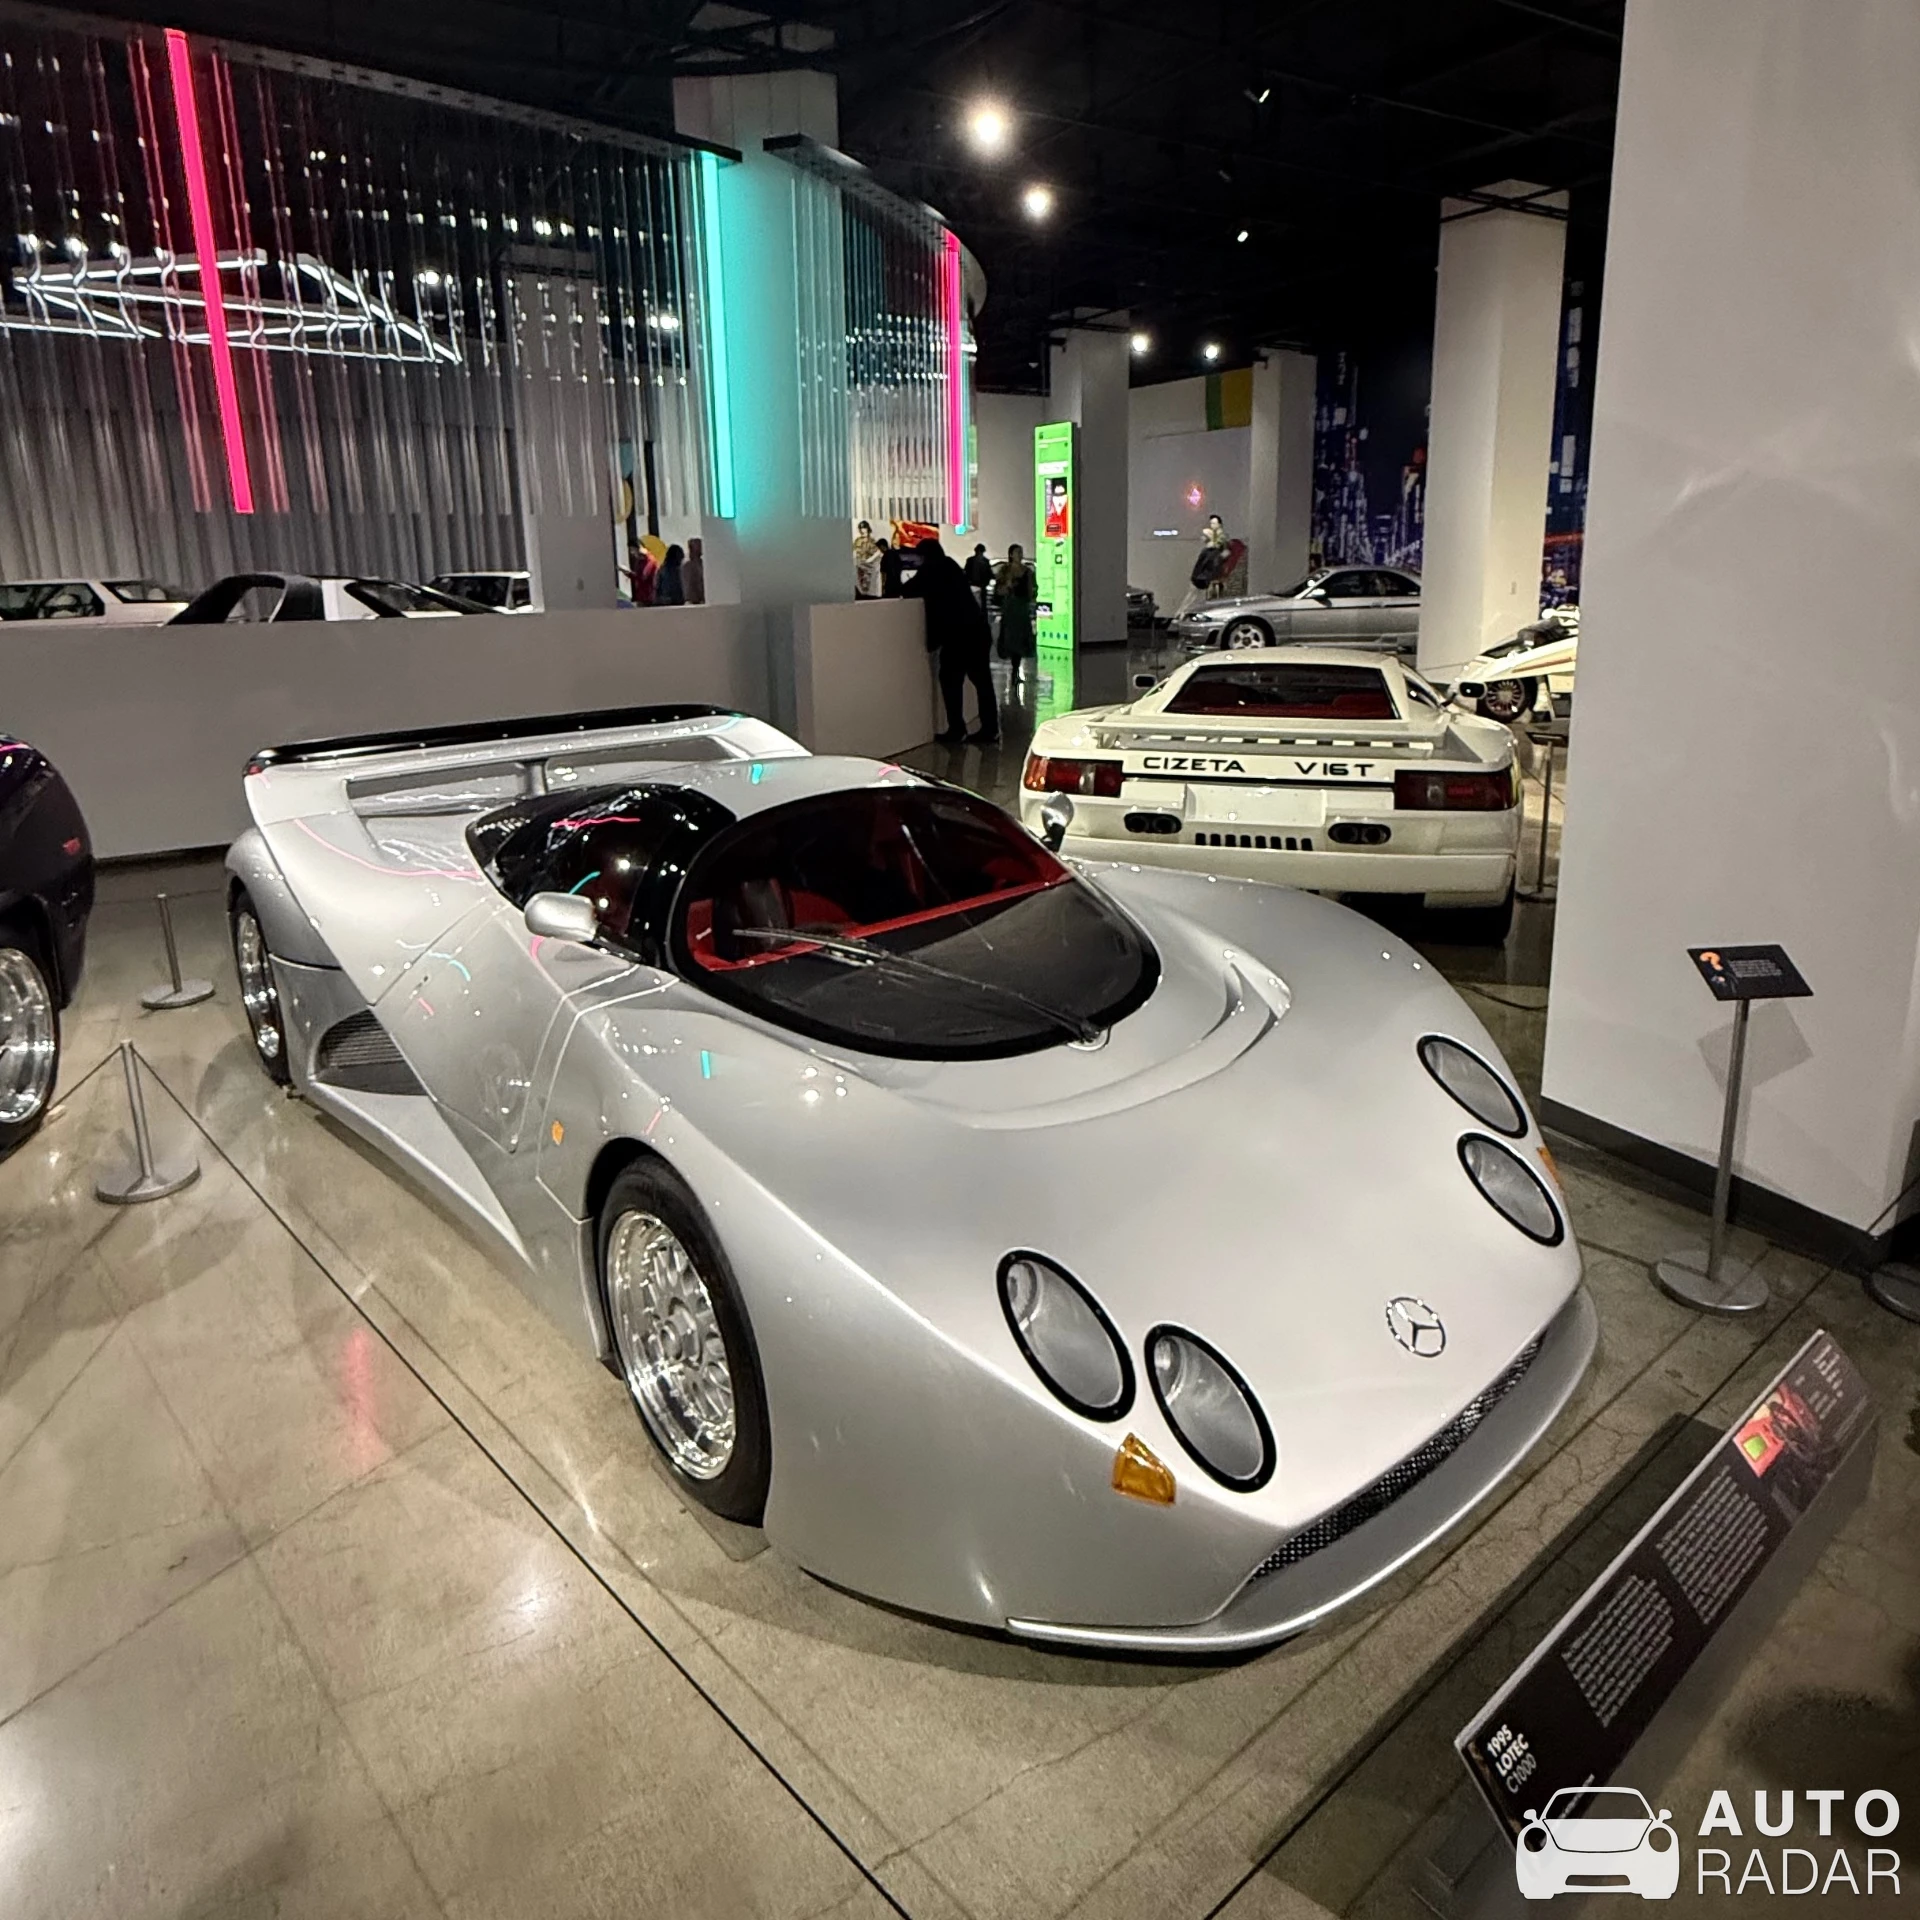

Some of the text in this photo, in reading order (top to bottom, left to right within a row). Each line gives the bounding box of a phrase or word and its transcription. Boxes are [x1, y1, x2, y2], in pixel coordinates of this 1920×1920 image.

[1143, 757, 1245, 773] CIZETA
[1486, 1723, 1513, 1758] 1995
[1495, 1733, 1529, 1777] LOTEC
[1506, 1752, 1537, 1794] C1000
